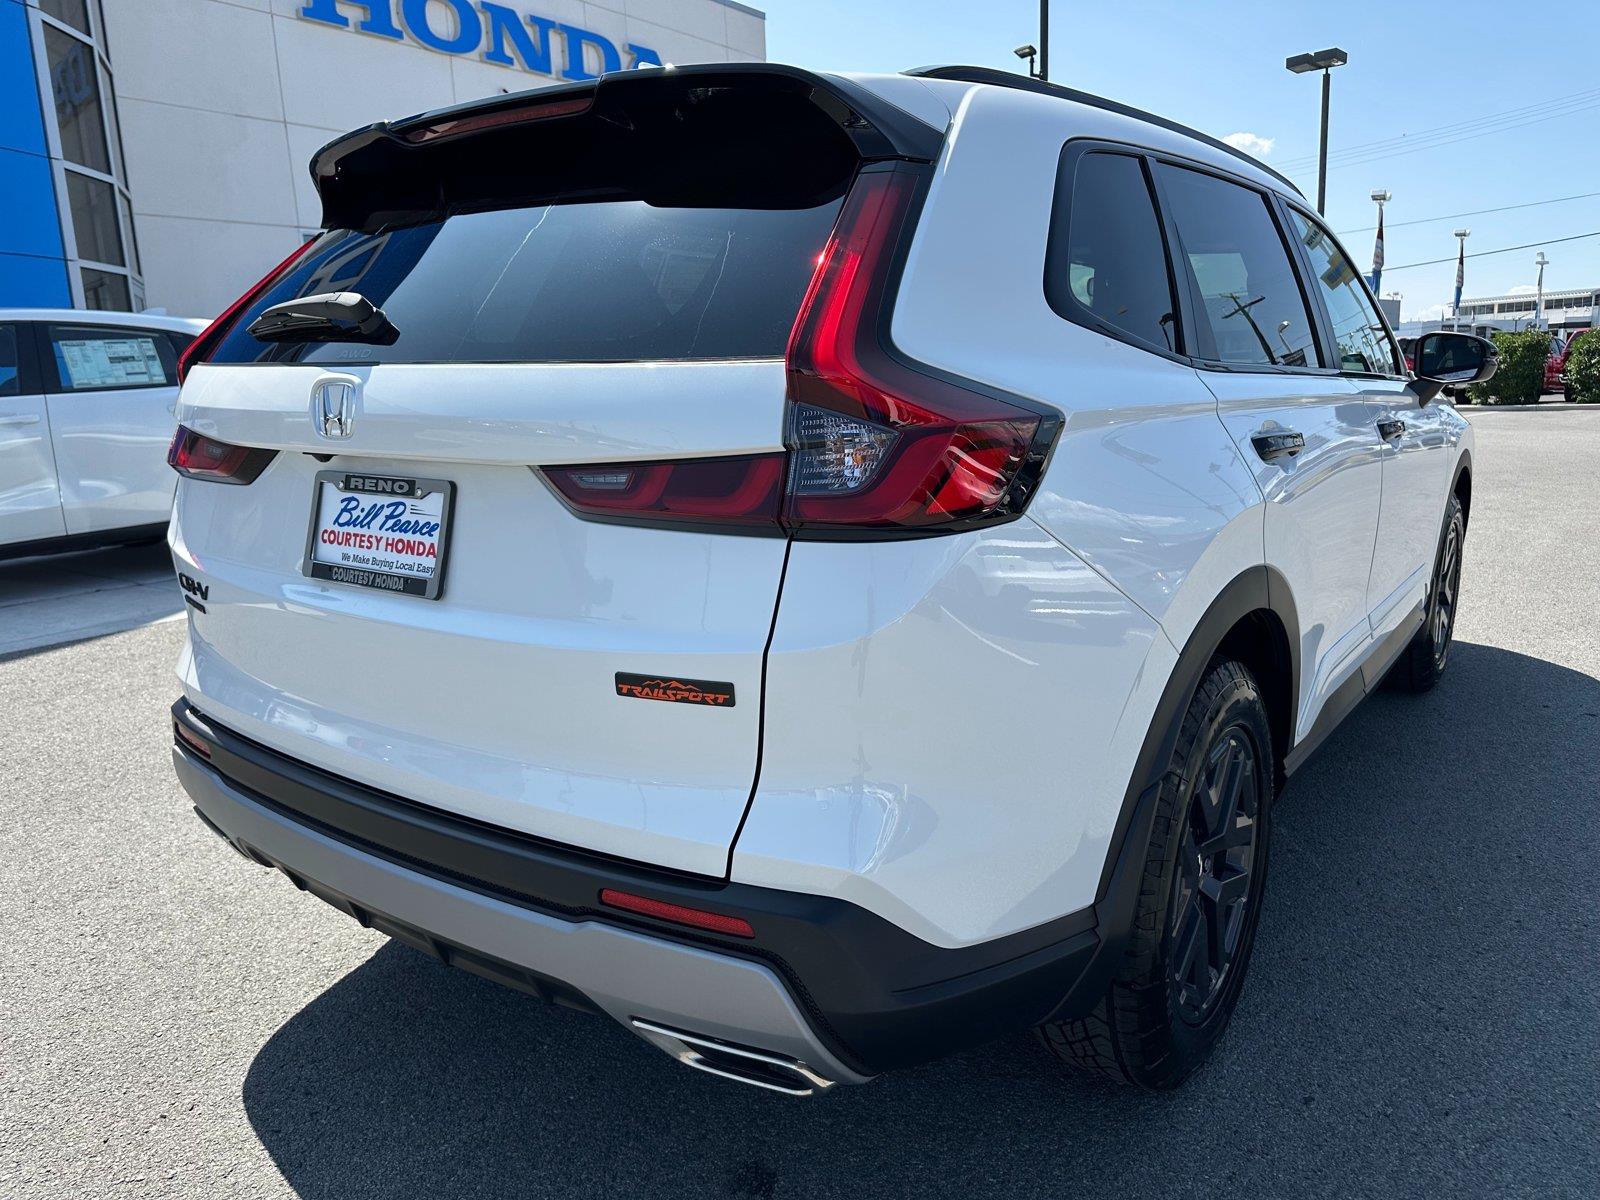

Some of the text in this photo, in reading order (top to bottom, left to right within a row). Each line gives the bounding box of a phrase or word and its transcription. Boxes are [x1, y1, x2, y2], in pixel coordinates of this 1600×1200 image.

[350, 477, 410, 494] RENO
[333, 496, 440, 537] Bill Pearce
[321, 529, 437, 558] COURTESY HONDA
[341, 552, 436, 576] We Make Buying Local Easy
[332, 567, 404, 591] COURTESY HONDA
[618, 684, 730, 705] TRAILSPORT
